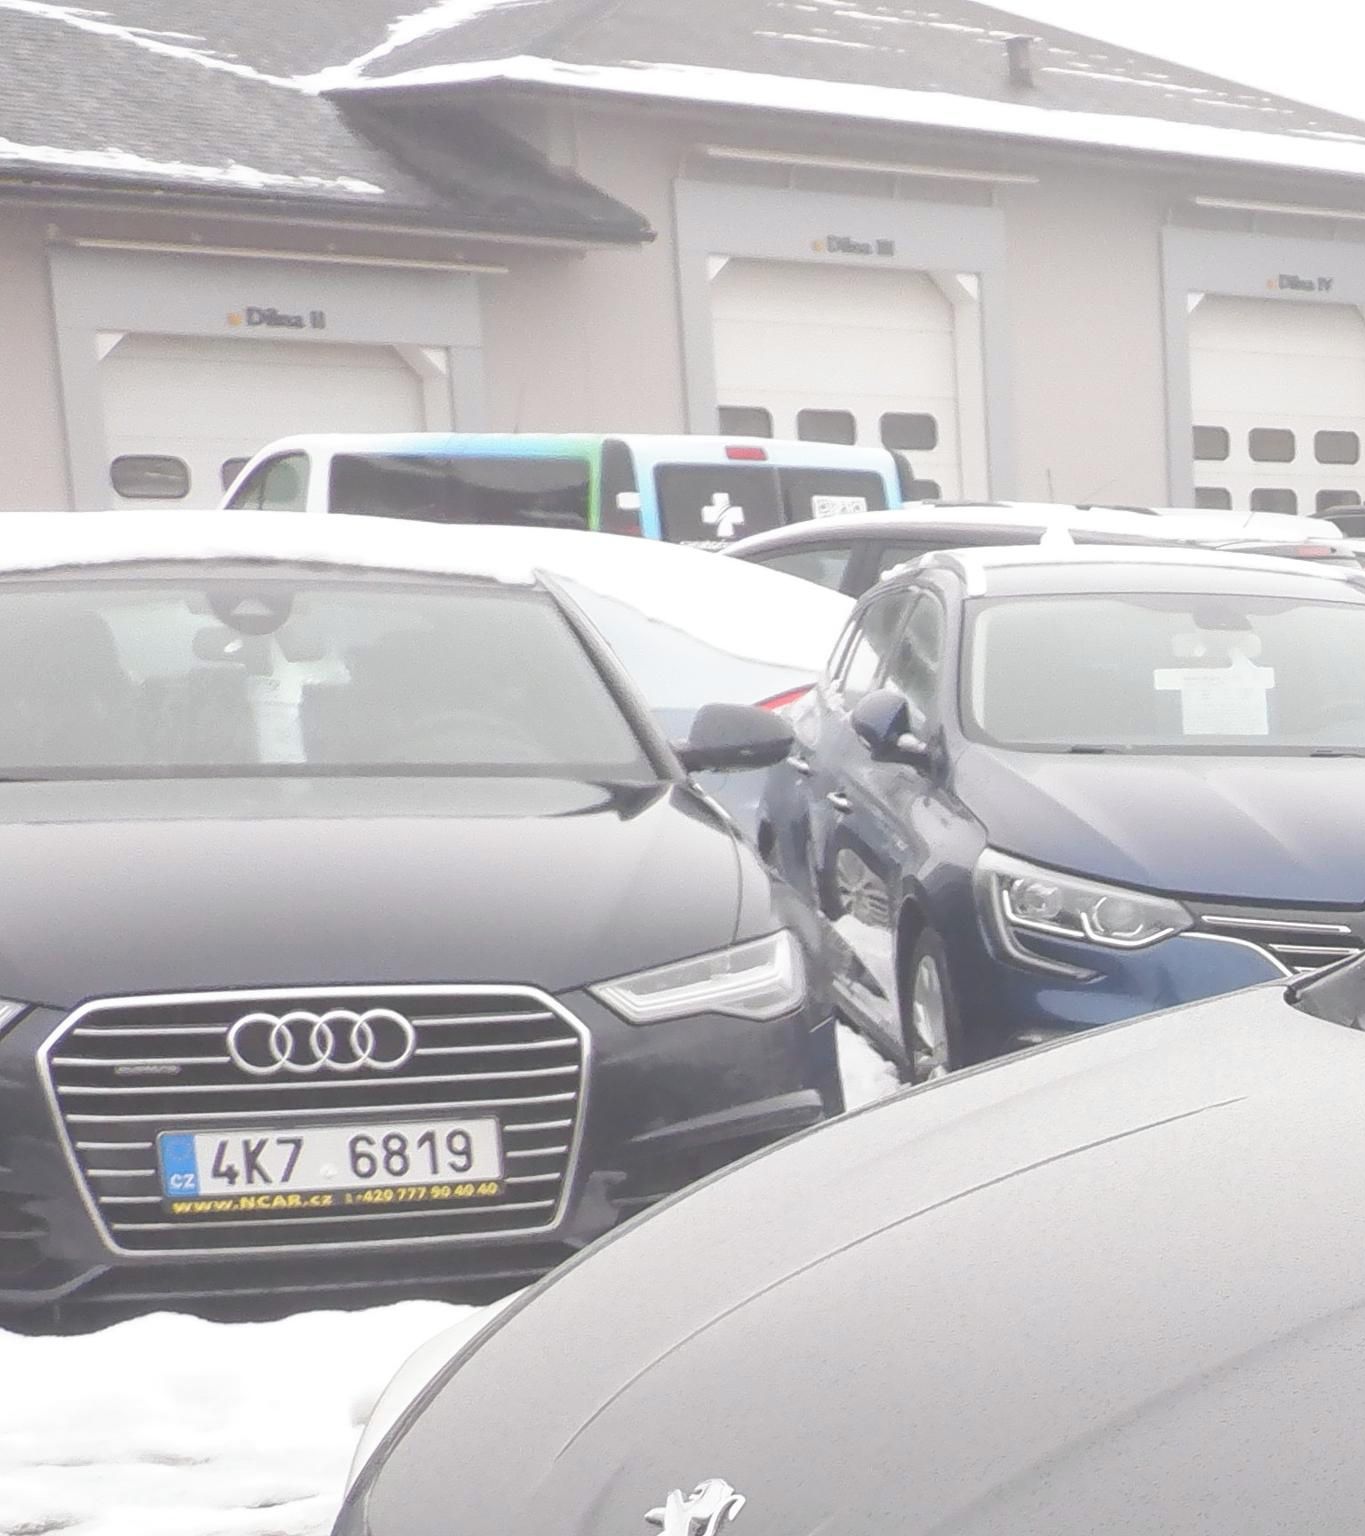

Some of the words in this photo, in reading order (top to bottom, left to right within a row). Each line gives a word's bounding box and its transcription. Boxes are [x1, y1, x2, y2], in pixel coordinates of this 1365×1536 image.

[170, 1173, 196, 1190] CZ
[210, 1136, 304, 1186] 4K7
[349, 1130, 473, 1179] 6819
[397, 1186, 427, 1201] 777
